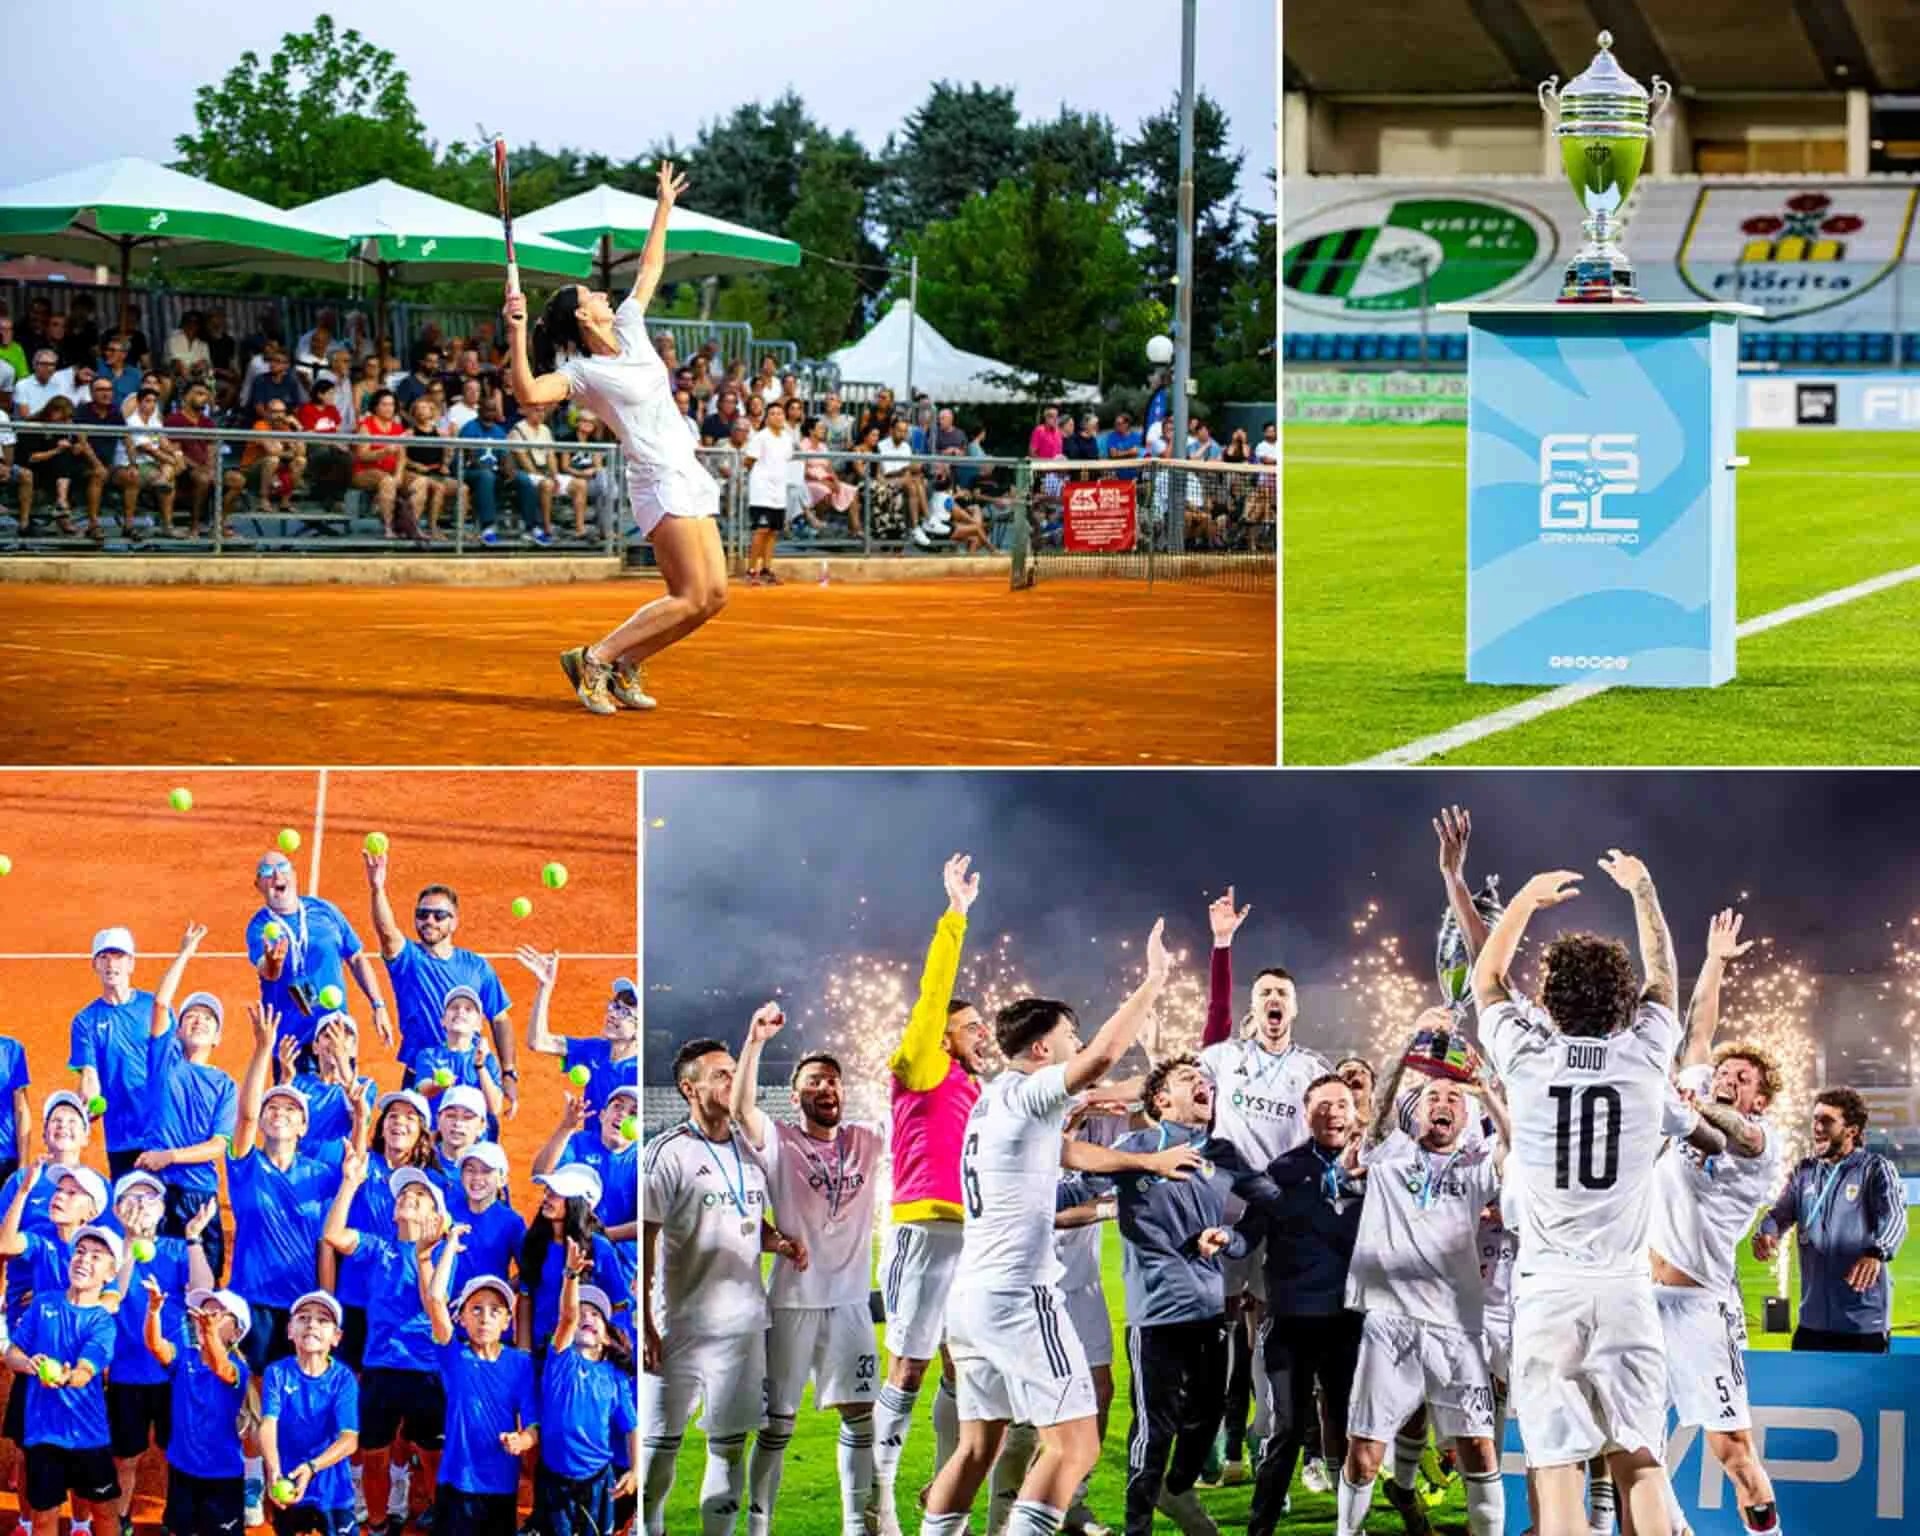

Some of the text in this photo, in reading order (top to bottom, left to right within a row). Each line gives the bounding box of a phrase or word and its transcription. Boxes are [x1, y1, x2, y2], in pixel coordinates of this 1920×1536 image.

[1421, 217, 1516, 232] VIRTUS
[1567, 1045, 1608, 1070] GUIDI
[1231, 1088, 1297, 1118] OYSTER
[1548, 1084, 1622, 1190] 10
[855, 1354, 875, 1379] 33
[1715, 1376, 1730, 1403] 5
